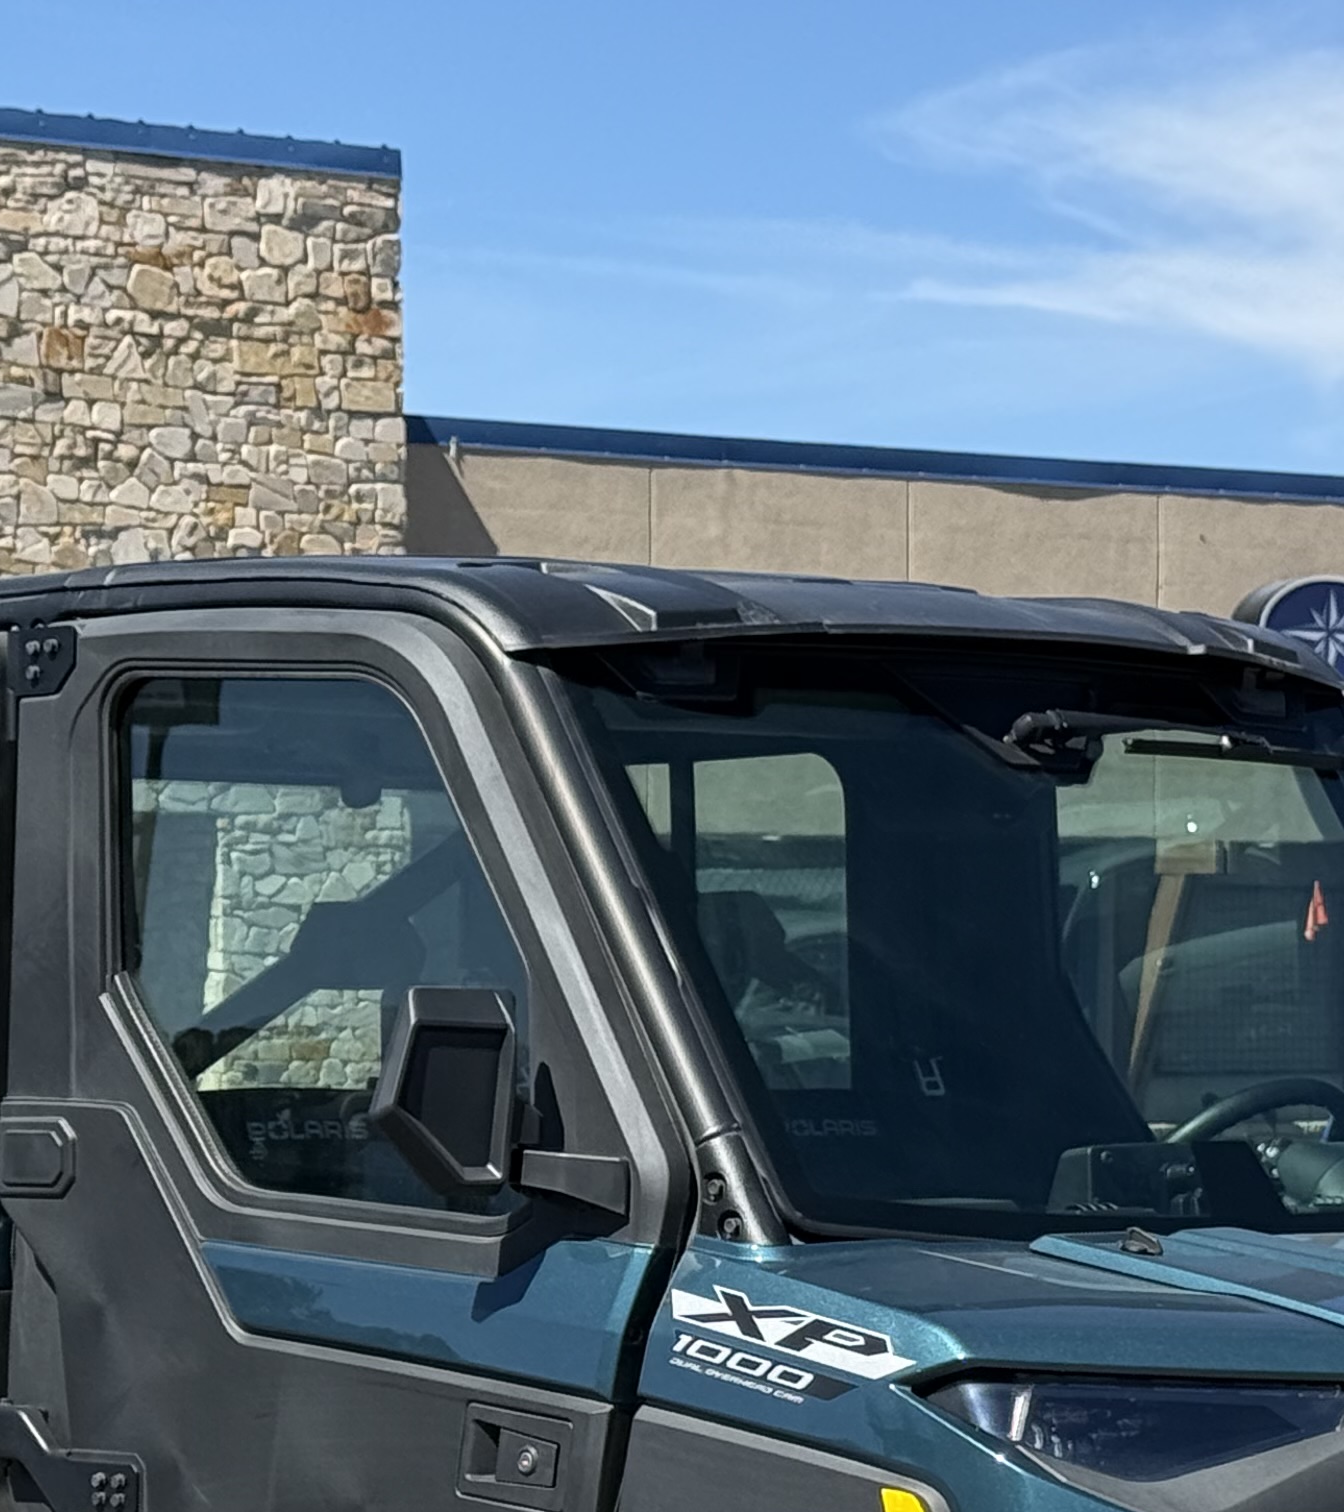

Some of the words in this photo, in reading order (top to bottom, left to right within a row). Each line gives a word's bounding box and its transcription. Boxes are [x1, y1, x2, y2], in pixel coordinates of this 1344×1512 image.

[246, 1119, 369, 1141] POLARIS
[677, 1288, 892, 1357] XP
[669, 1357, 703, 1375] DUAL
[705, 1368, 774, 1394] OVERHEAD
[773, 1387, 805, 1405] CAM
[672, 1333, 814, 1391] 1000
